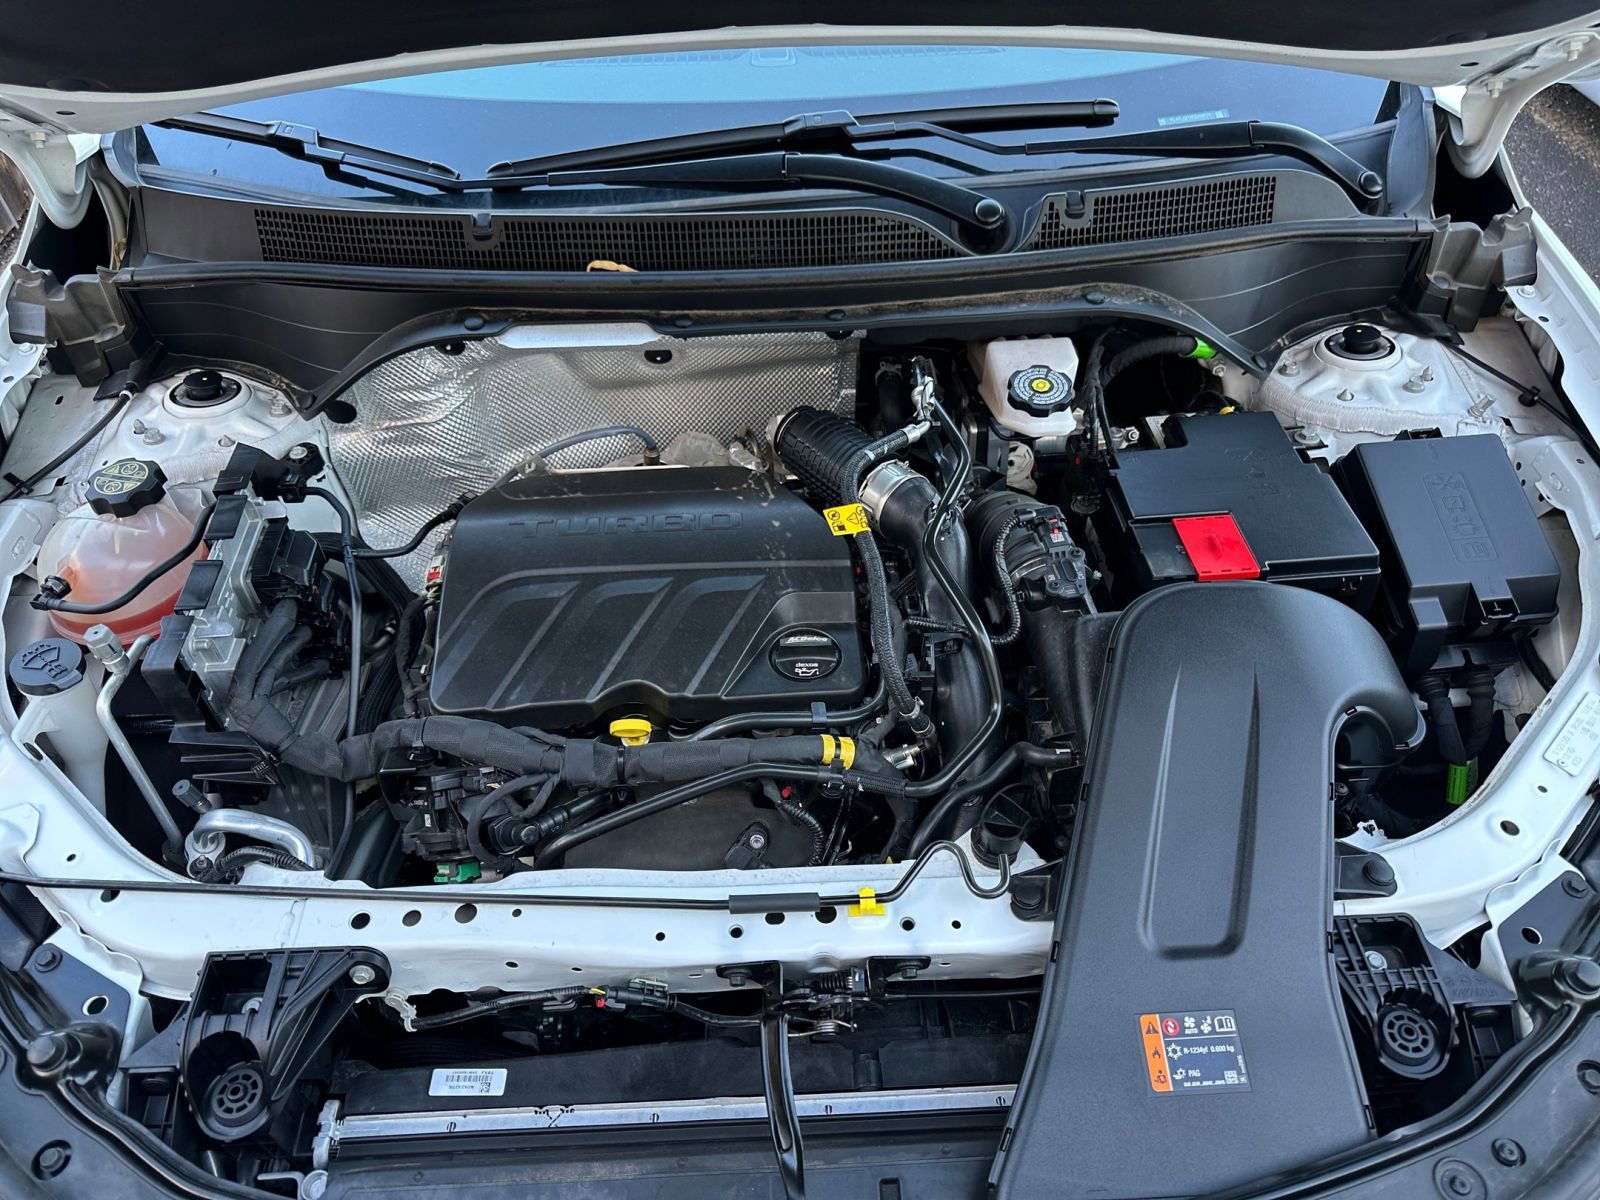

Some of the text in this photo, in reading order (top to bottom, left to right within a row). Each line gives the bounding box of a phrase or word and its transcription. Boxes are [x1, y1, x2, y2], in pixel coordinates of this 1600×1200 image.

[509, 512, 743, 539] TURBO
[785, 635, 828, 643] ACDelco
[1226, 1044, 1235, 1053] kg
[1188, 1069, 1201, 1077] PAG
